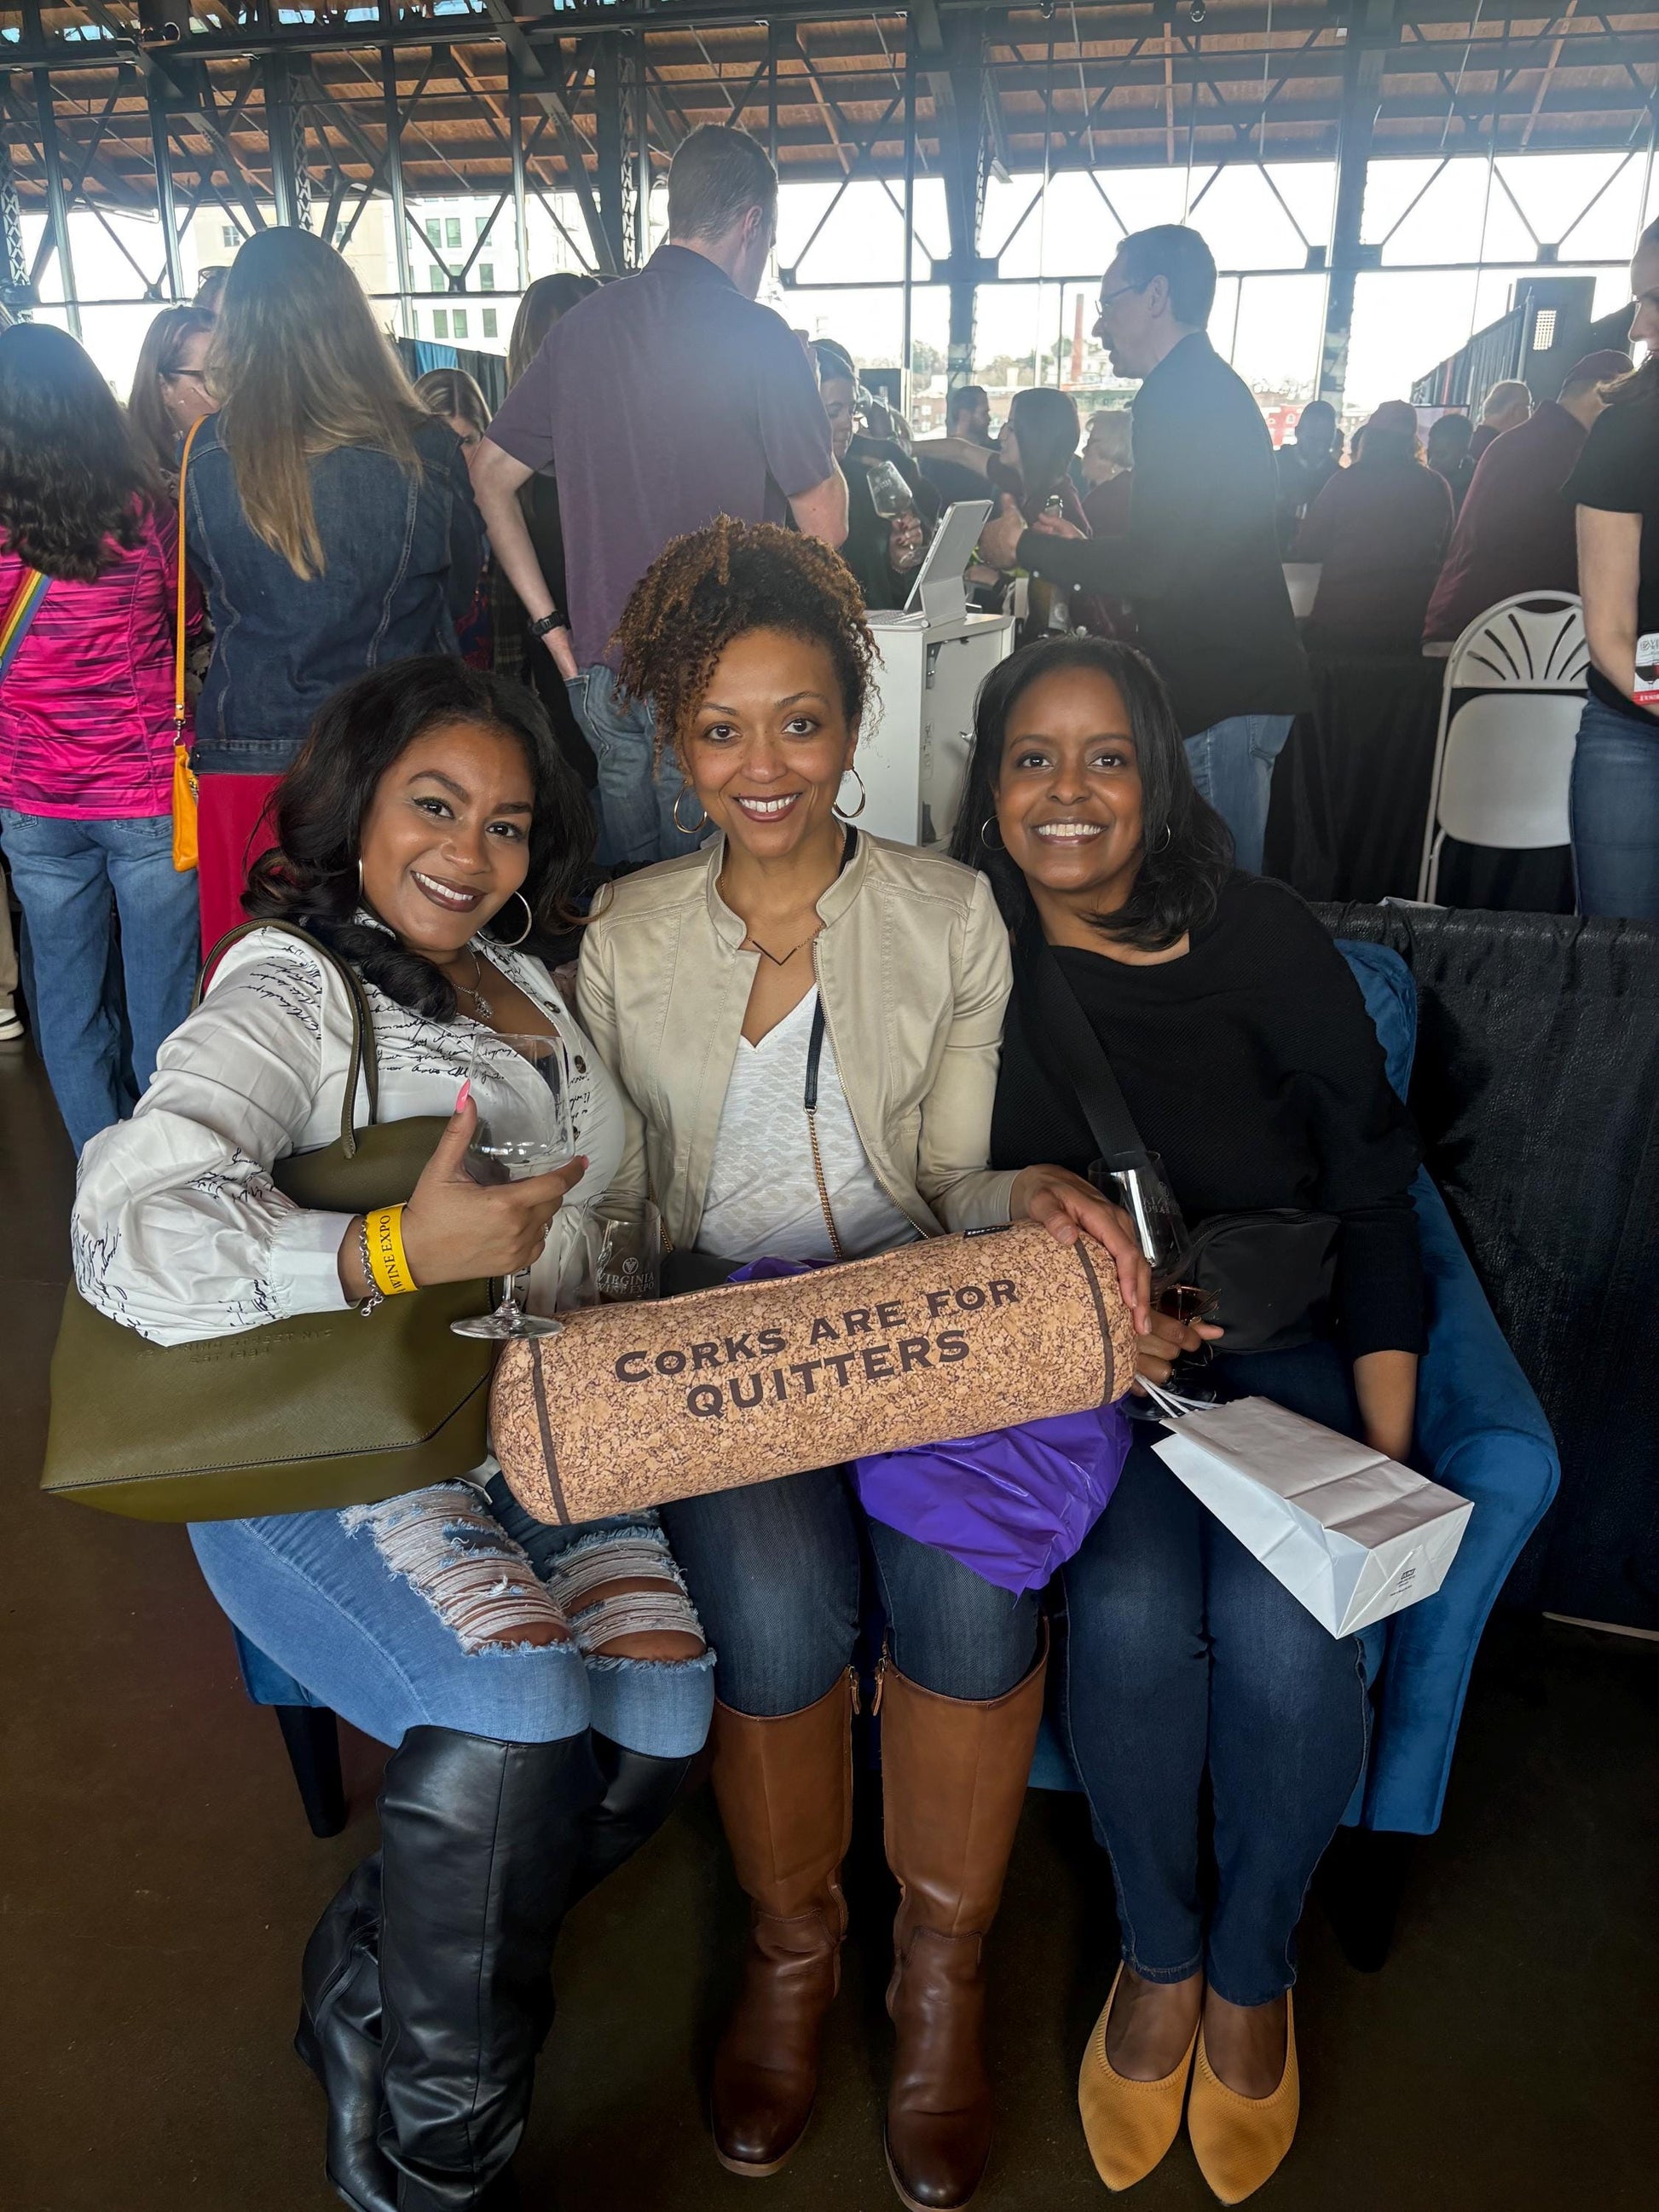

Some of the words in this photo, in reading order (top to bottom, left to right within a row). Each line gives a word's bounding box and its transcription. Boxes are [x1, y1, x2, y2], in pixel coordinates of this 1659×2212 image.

[379, 1215, 393, 1252] EXPO
[384, 1254, 403, 1289] WINE
[598, 1272, 654, 1285] VIRGINIA
[598, 1282, 627, 1294] WINE
[629, 1281, 655, 1294] EXPO
[615, 1328, 786, 1383] CORKS
[810, 1299, 906, 1345] ARE
[926, 1279, 1019, 1319] FOR
[687, 1330, 970, 1419] QUITTERS
